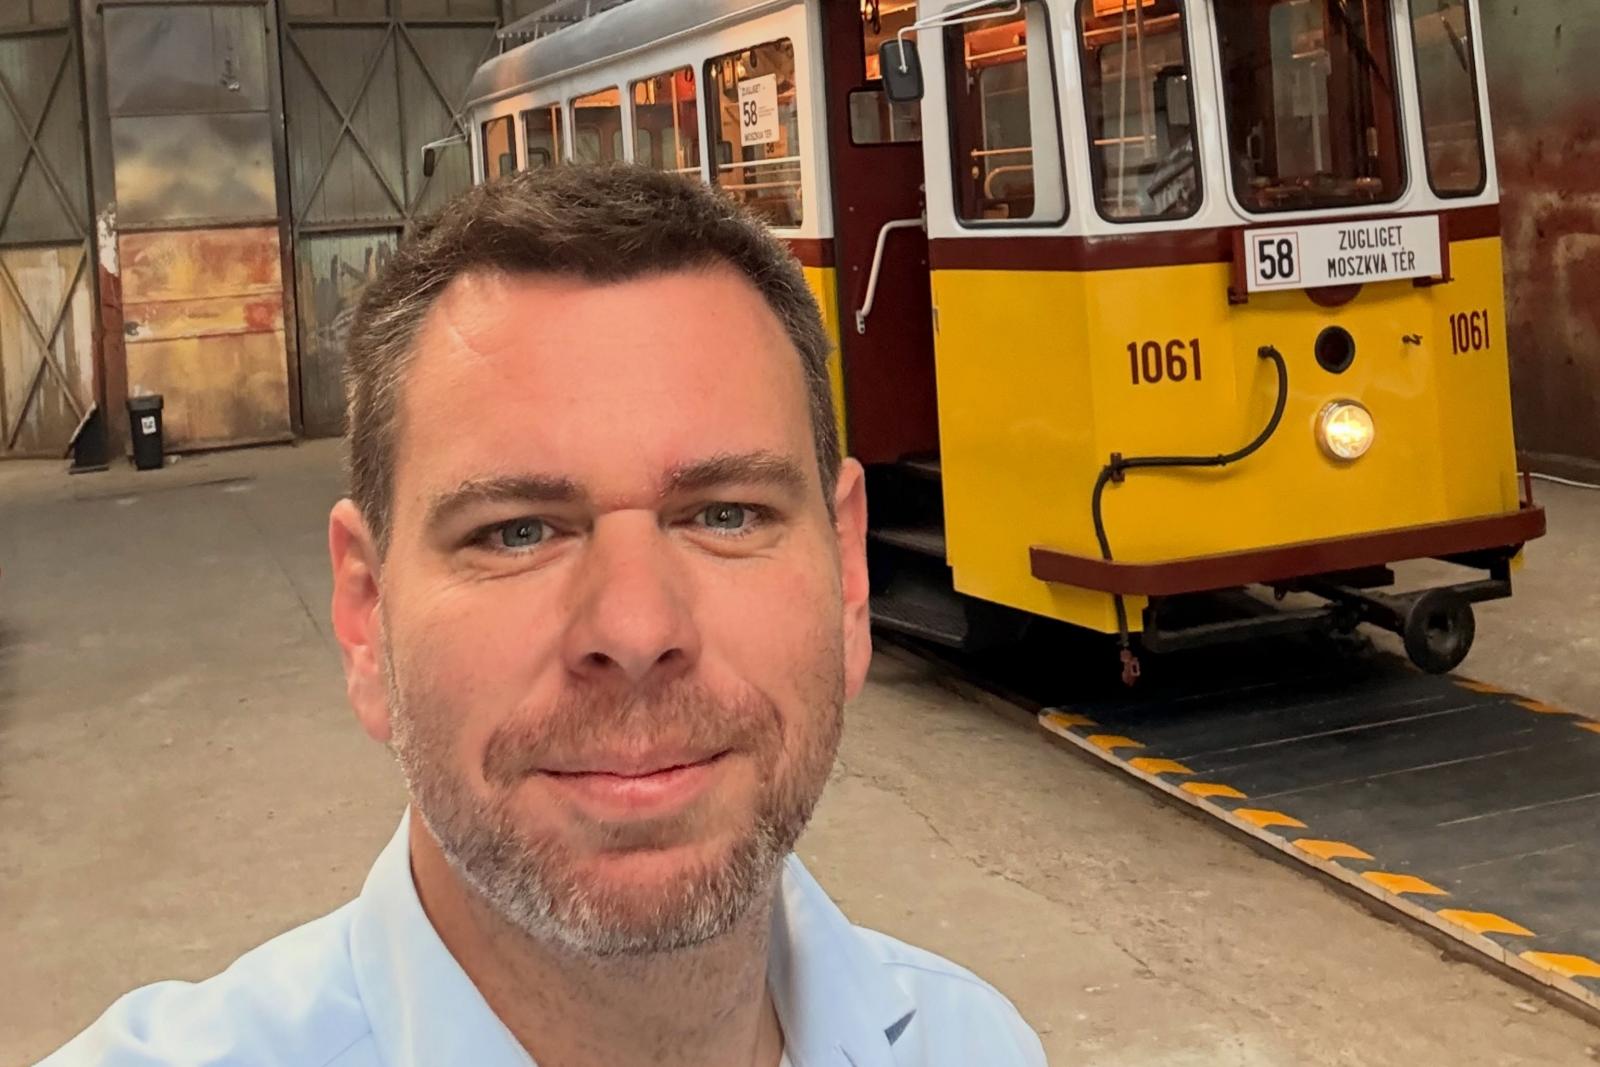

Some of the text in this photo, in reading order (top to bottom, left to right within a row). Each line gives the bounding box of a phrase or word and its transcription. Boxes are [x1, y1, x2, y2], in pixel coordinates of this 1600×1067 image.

[743, 100, 757, 127] 58
[1338, 226, 1402, 250] ZUGLIGET
[1258, 239, 1294, 280] 58
[1328, 247, 1415, 278] MOSZKVA TÉR
[1449, 309, 1490, 355] 1061
[1127, 338, 1203, 385] 1061
